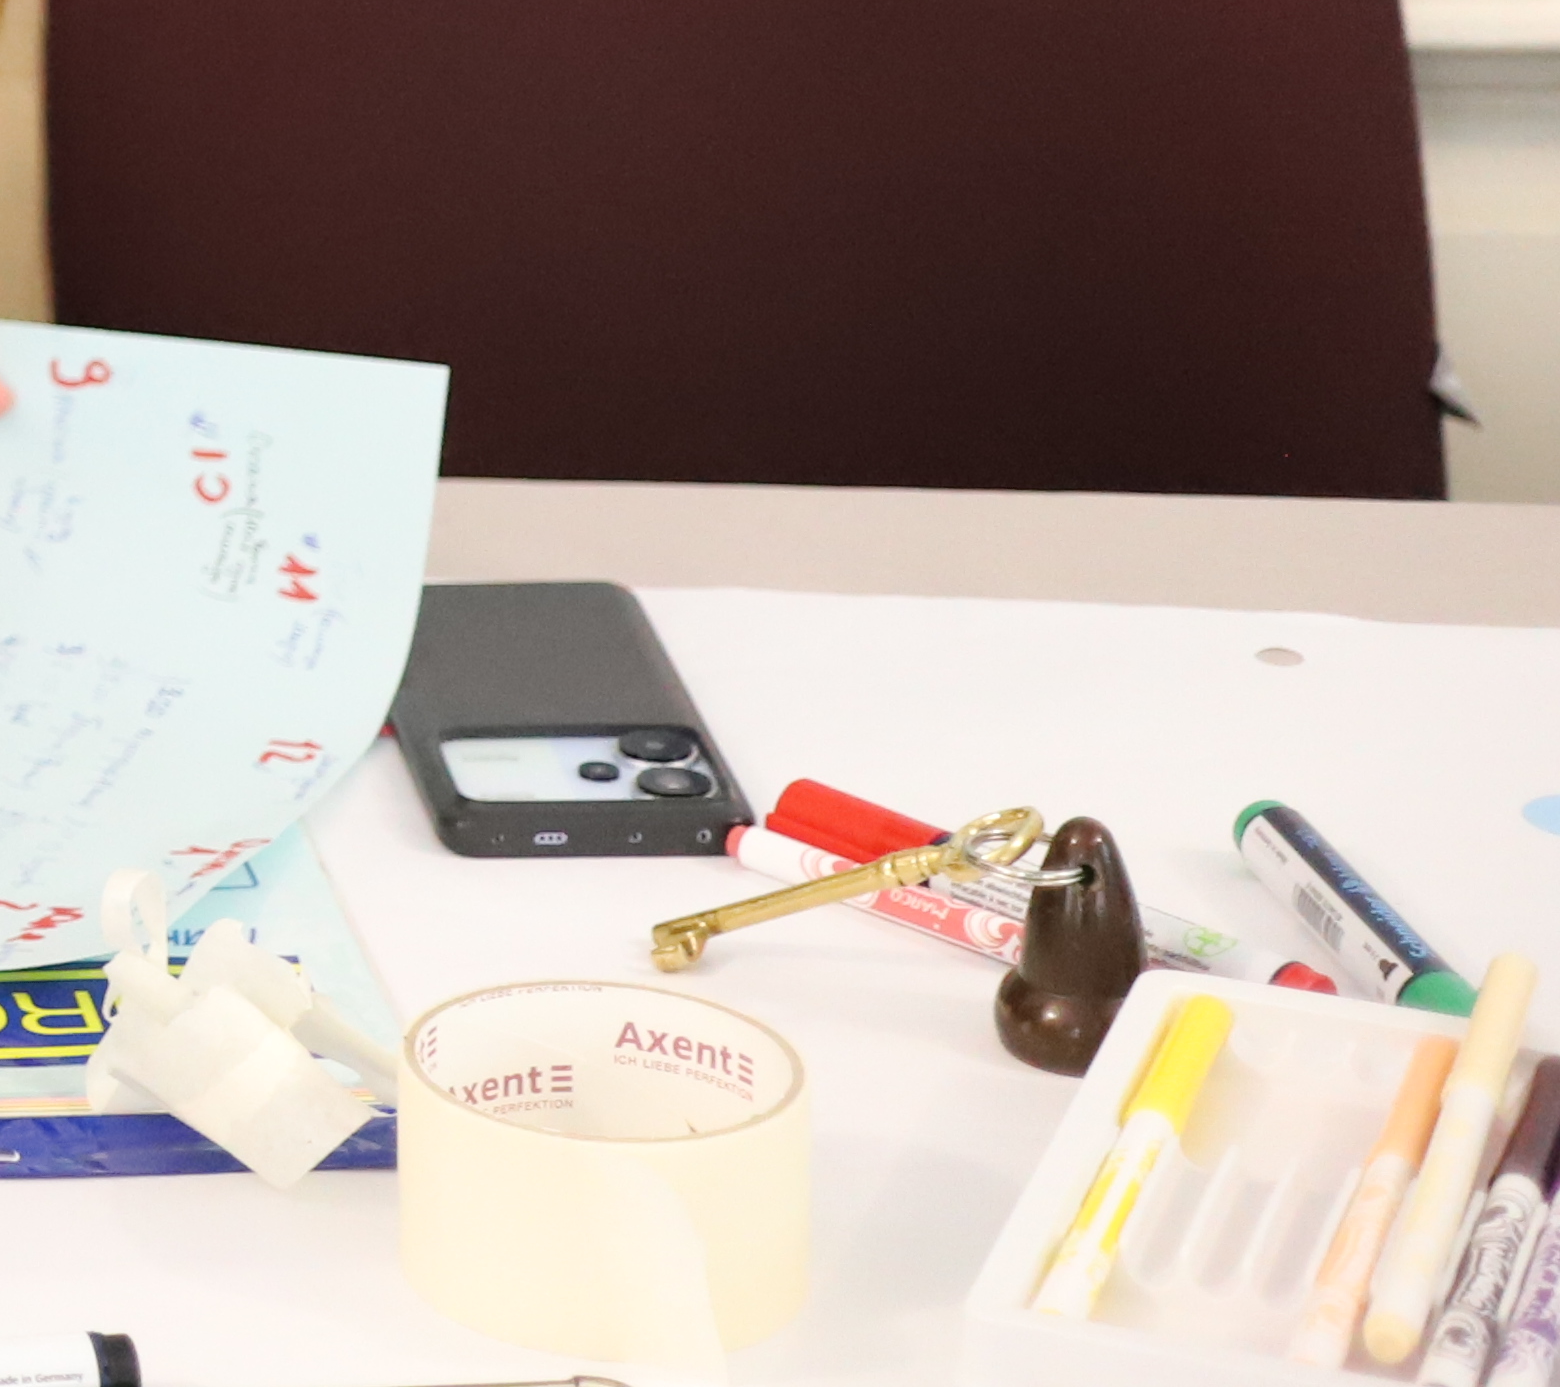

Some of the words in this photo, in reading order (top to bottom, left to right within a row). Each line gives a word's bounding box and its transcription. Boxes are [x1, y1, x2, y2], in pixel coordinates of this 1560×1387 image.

[50, 359, 112, 388] 9
[191, 447, 232, 504] 10
[278, 554, 320, 603] 11
[259, 739, 324, 764] 12
[614, 1021, 732, 1076] Axent
[613, 1055, 638, 1066] ICH
[643, 1059, 680, 1075] LIEBE
[685, 1068, 754, 1102] PERFEKTION
[493, 1098, 574, 1115] PERFEKTION
[22, 1375, 32, 1384] in
[35, 1373, 83, 1383] Germany
